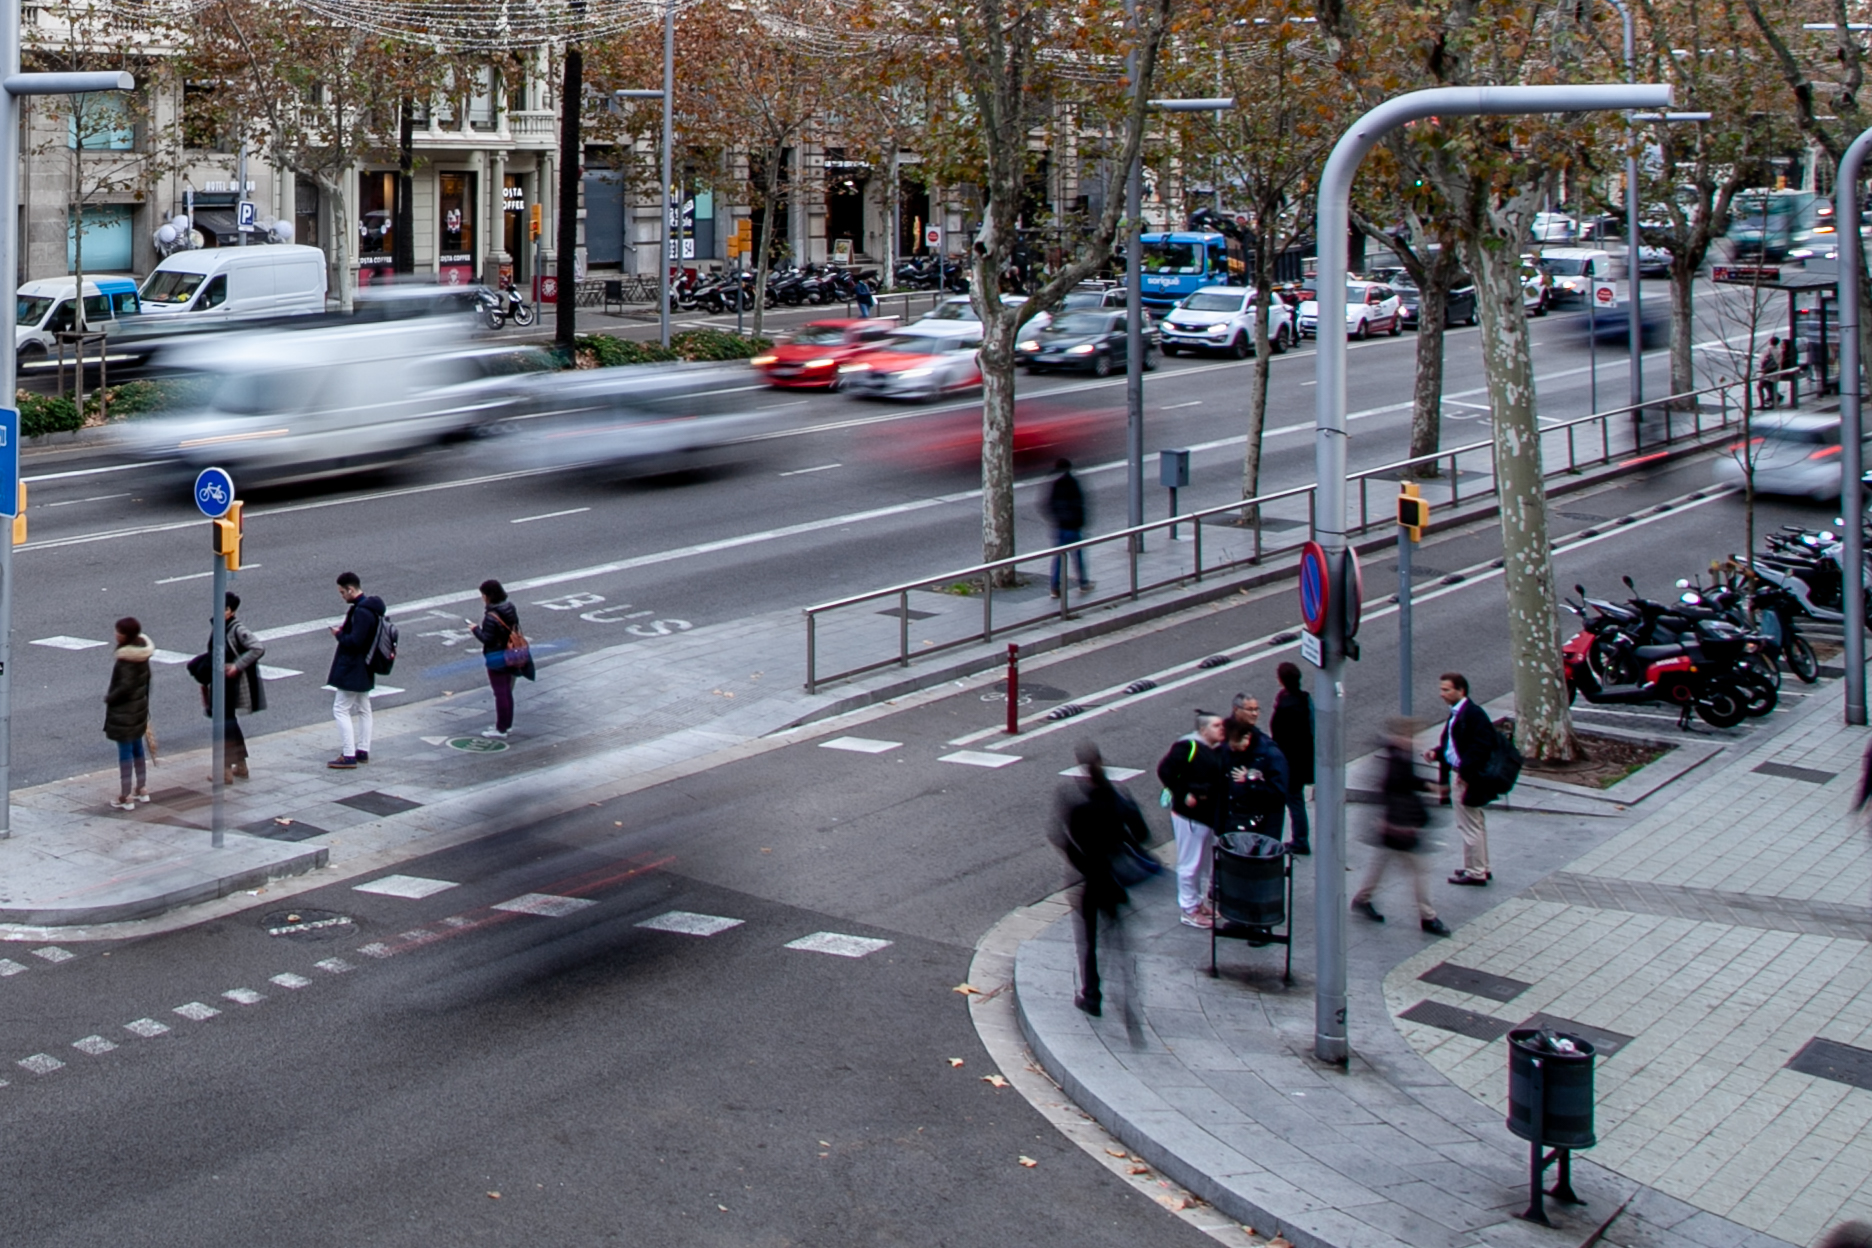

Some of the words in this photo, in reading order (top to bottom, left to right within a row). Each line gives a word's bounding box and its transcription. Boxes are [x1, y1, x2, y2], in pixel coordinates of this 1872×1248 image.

[502, 188, 523, 198] OSTA
[503, 200, 525, 210] OFFEE
[242, 205, 252, 223] P
[373, 256, 392, 264] COFFEE
[453, 254, 471, 262] COFFEE
[531, 592, 693, 637] BUS
